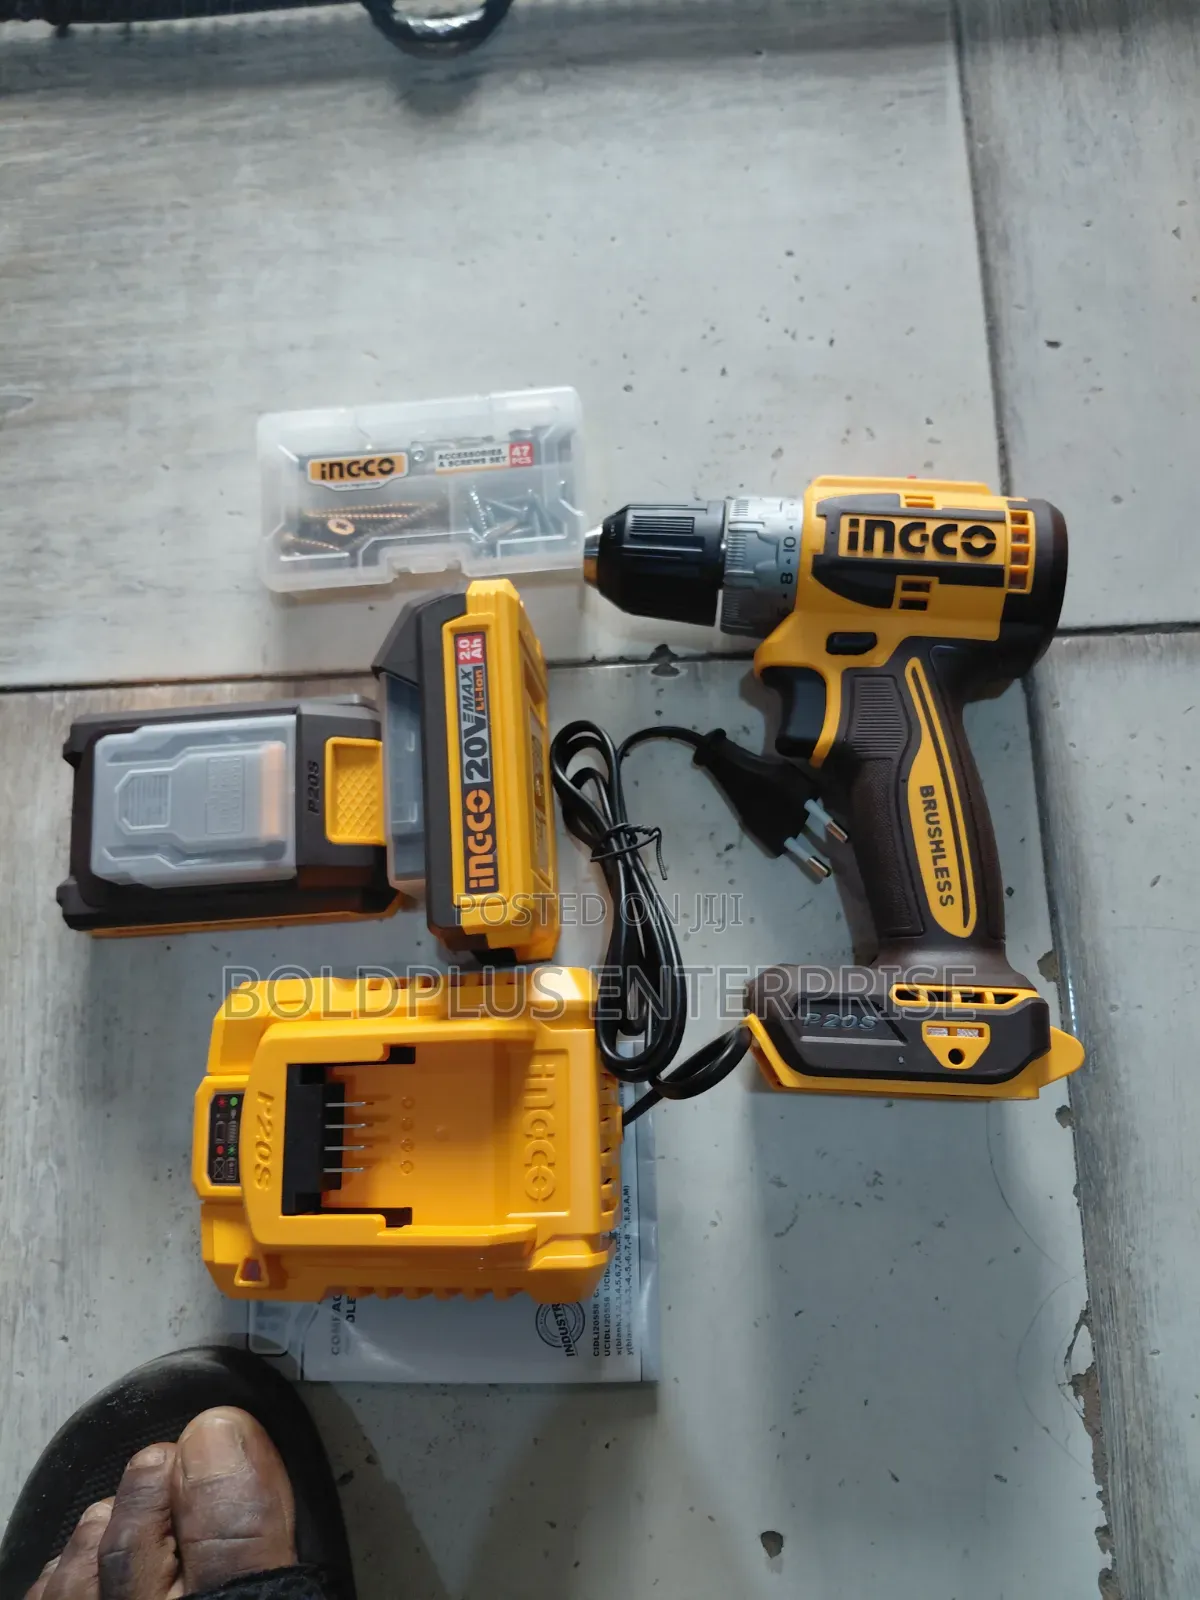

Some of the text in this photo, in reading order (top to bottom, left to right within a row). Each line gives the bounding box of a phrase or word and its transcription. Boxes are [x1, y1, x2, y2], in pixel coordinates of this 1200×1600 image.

[438, 448, 502, 460] ACCESSORIES
[448, 457, 486, 467] SCREWS
[490, 455, 508, 464] SET
[511, 445, 531, 457] 47
[511, 456, 533, 465] PCS
[321, 457, 395, 480] INGCO
[782, 537, 797, 553] 10
[847, 518, 998, 558] INGCO
[780, 572, 794, 585] 8
[458, 638, 471, 661] 2.0
[470, 637, 483, 659] Ah
[463, 710, 490, 782] 20V
[307, 760, 320, 815] P20S
[465, 788, 496, 889] INGCO
[919, 784, 955, 908] BRUSHLESS
[803, 1011, 879, 1031] P20S
[254, 1090, 275, 1191] P20S
